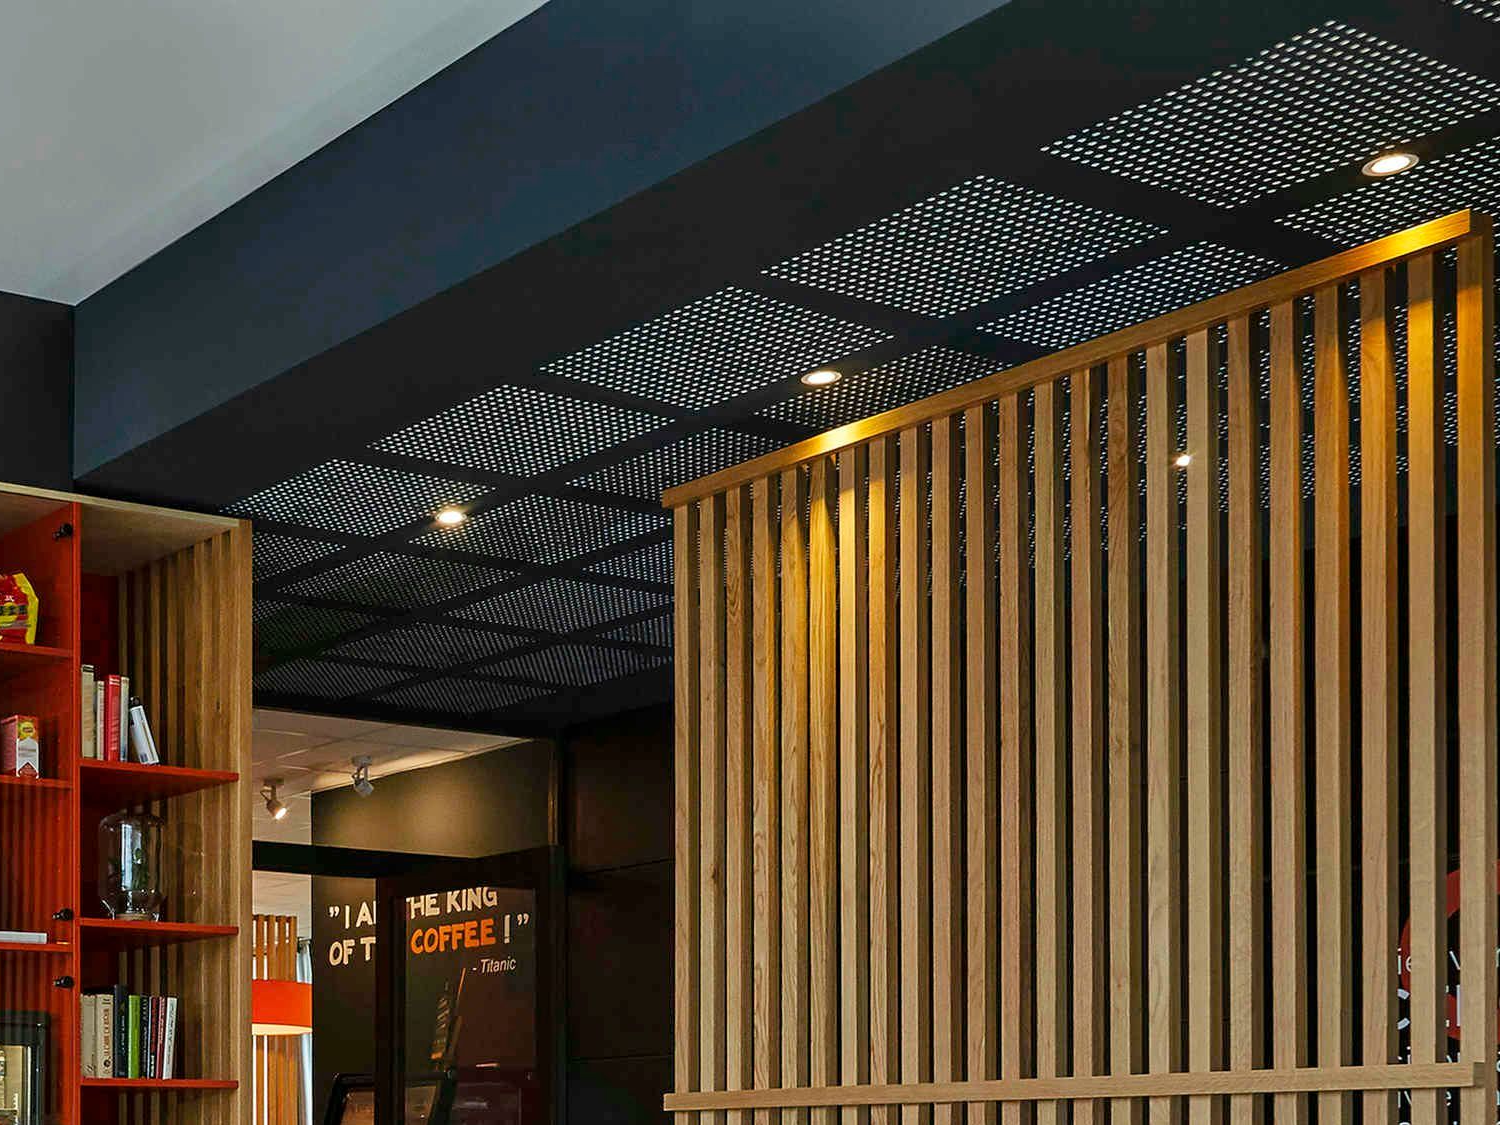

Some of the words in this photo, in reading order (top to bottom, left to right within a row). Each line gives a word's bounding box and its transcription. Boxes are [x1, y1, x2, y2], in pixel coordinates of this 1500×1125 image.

[406, 893, 440, 919] HE
[446, 886, 498, 913] KING
[328, 939, 355, 966] OF
[410, 918, 497, 955] COFFEE
[479, 956, 517, 974] Titanic
